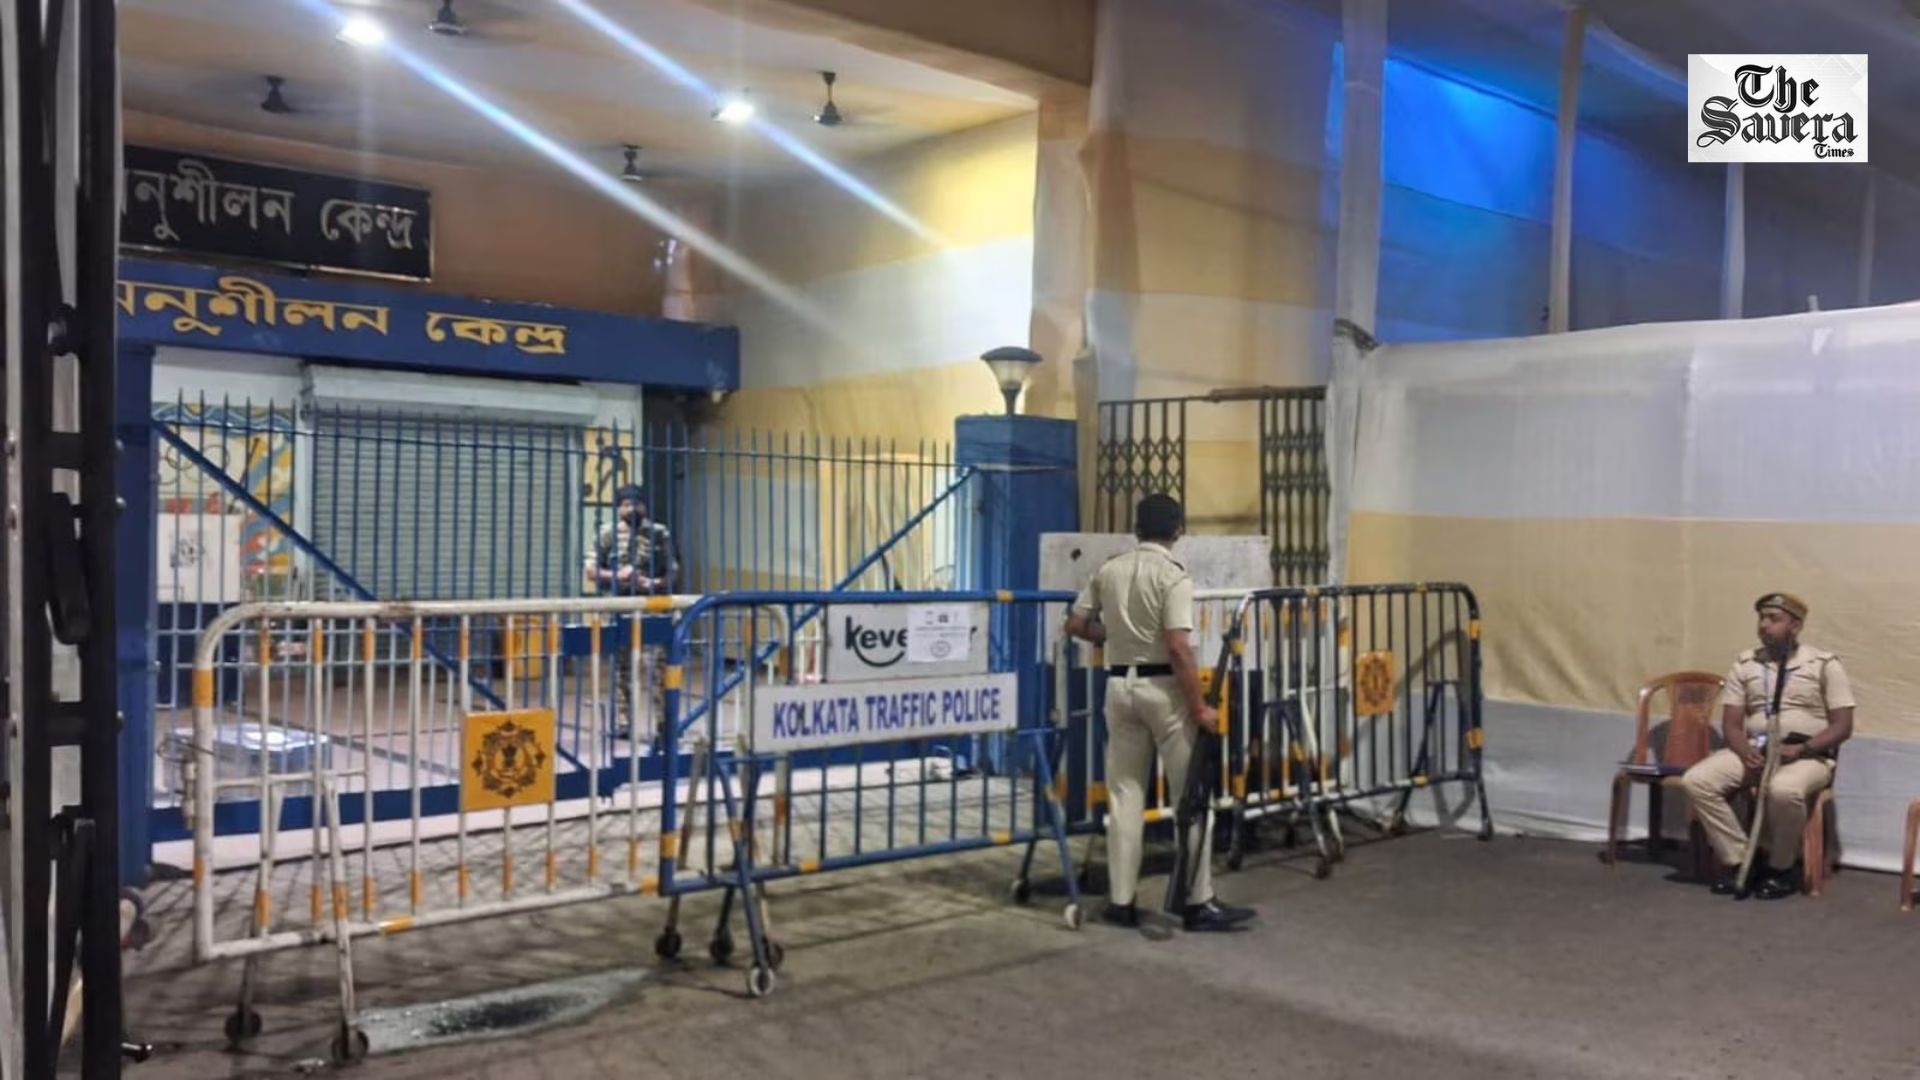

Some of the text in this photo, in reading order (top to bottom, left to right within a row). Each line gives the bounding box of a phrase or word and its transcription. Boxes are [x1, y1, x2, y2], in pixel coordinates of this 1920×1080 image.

[320, 199, 417, 250] কেন্দ্র
[426, 311, 568, 354] কেন্দ্র
[773, 687, 1000, 738] KOLKATA TRAFFIC POLICE
